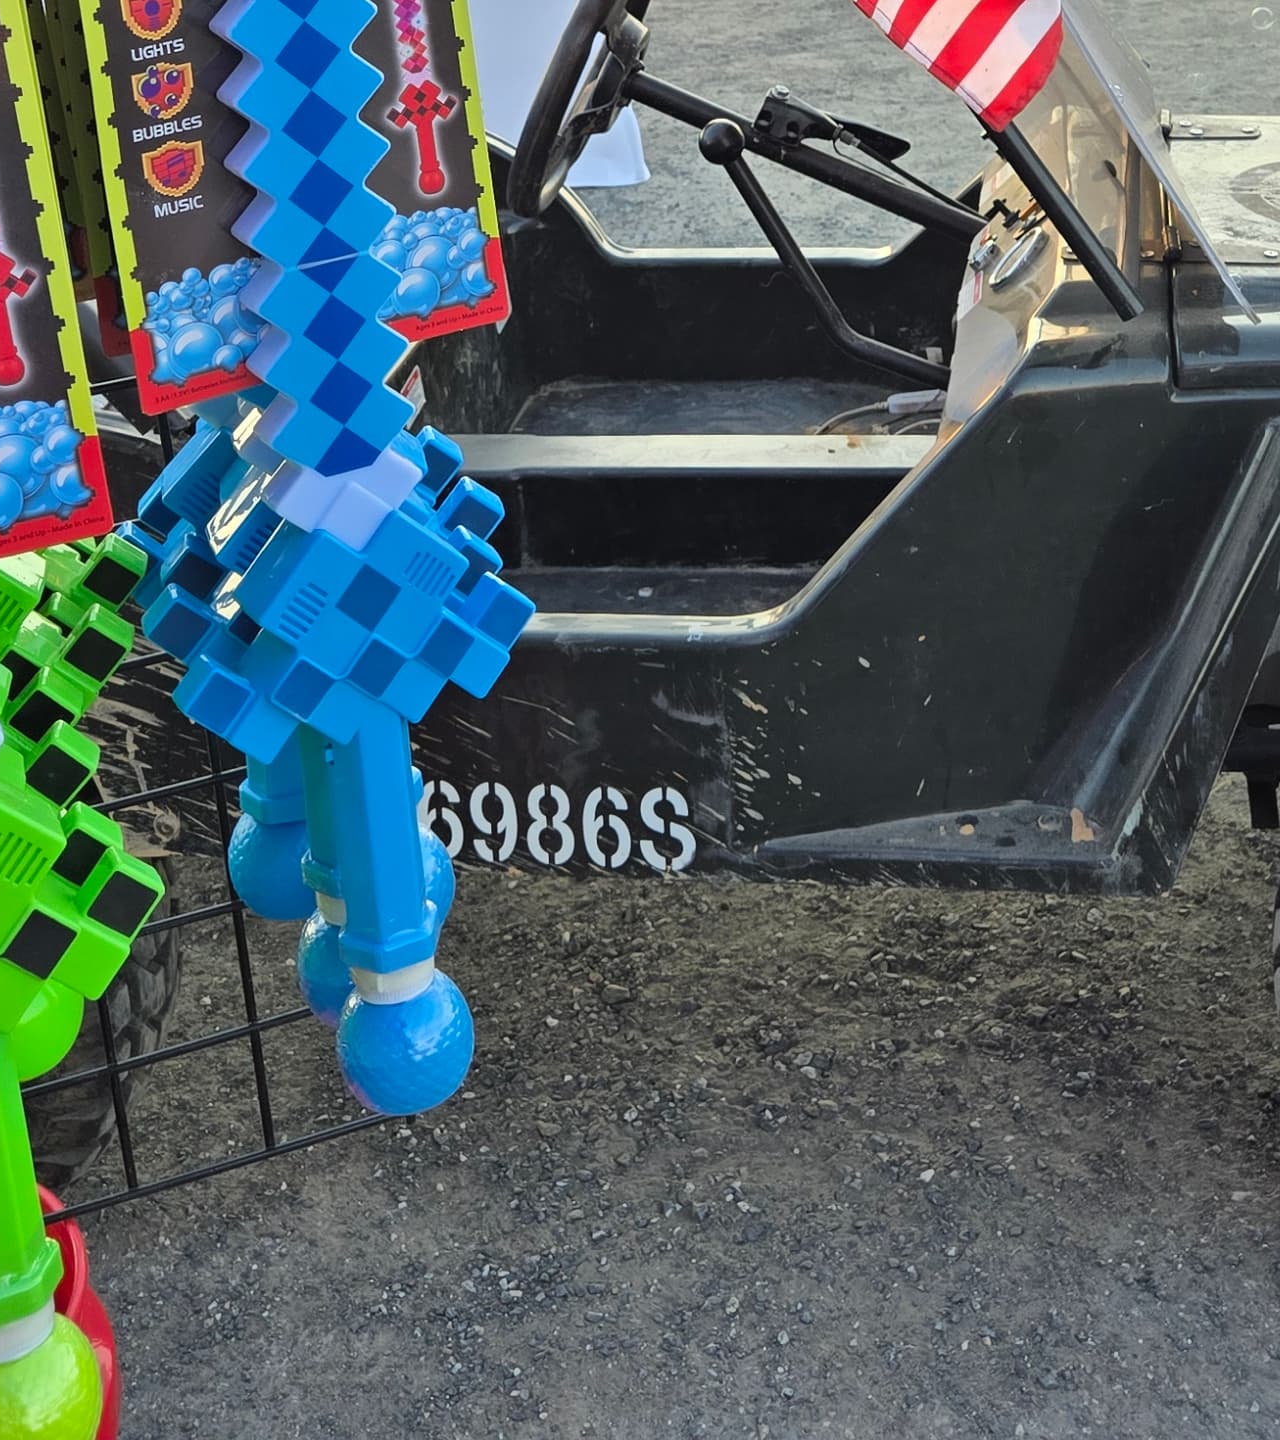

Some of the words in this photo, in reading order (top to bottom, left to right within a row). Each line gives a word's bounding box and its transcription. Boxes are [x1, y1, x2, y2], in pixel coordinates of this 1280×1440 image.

[131, 38, 185, 62] LIGHTS
[132, 115, 203, 143] BUBBLES
[154, 195, 204, 219] MUSIC
